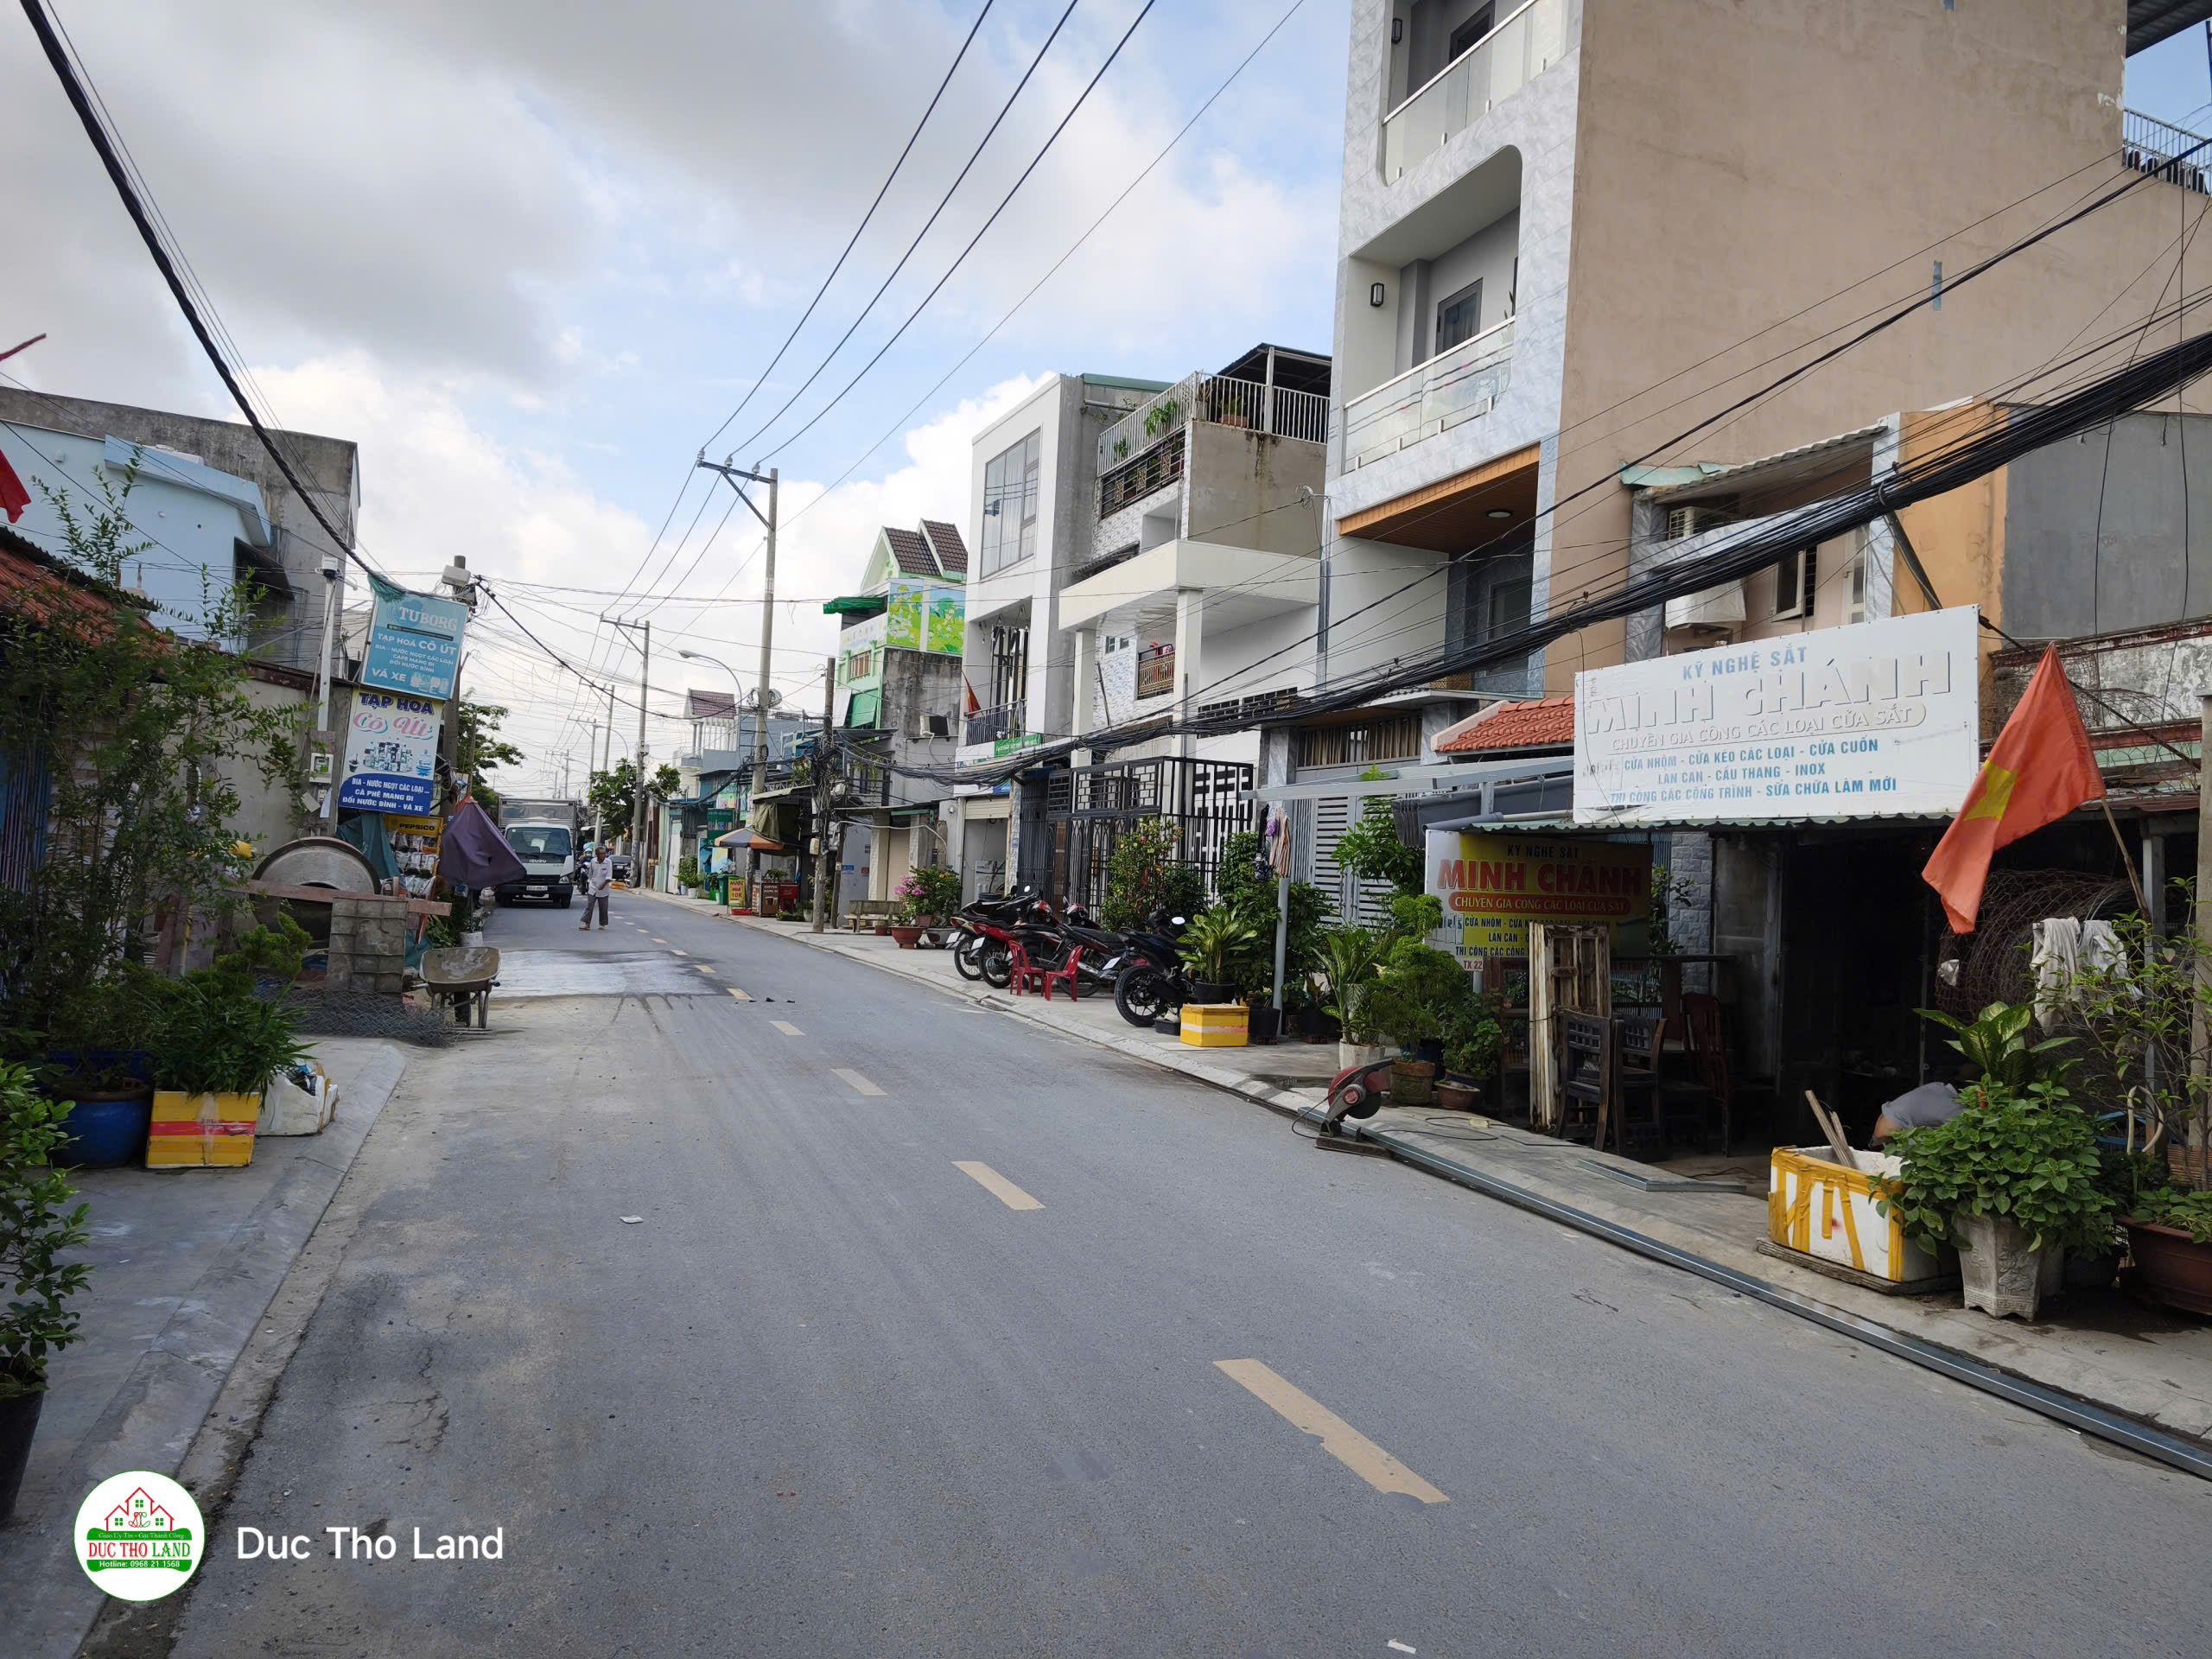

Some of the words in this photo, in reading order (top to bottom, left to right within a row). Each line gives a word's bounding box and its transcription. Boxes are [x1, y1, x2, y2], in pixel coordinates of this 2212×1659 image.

[398, 607, 458, 631] TUBORG
[419, 640, 437, 651] CÔ
[440, 644, 457, 655] ÚT
[1770, 643, 1808, 667] SẮT
[372, 668, 388, 678] VÁ
[391, 671, 407, 682] XE
[359, 692, 394, 709] TẠP
[1588, 684, 1713, 734] MINH
[1734, 652, 1951, 716] CHÁNH
[1670, 733, 1694, 745] GIA
[1700, 726, 1740, 742] CÔNG
[1748, 721, 1779, 738] CÁC
[1714, 749, 1735, 764] KÉO
[1739, 747, 1763, 762] CÁC
[1768, 746, 1795, 760] LOẠI
[1809, 740, 1835, 756] CỬA
[1658, 773, 1678, 785] LAN
[1681, 772, 1703, 783] CAN
[1742, 766, 1780, 780] THANG
[1796, 763, 1825, 776] INOX
[1611, 793, 1625, 804] THI
[1662, 788, 1681, 801] CÁC
[1835, 777, 1863, 793] LÀM
[1869, 776, 1897, 791] MỚI
[399, 823, 435, 831] PEPSICO
[1437, 859, 1528, 892] MINH
[1496, 898, 1512, 909] GIA
[1489, 932, 1502, 943] LAN
[1504, 933, 1518, 943] CAN
[1456, 946, 1466, 956] THI
[1464, 960, 1471, 969] TX
[1474, 960, 1483, 969] 22
